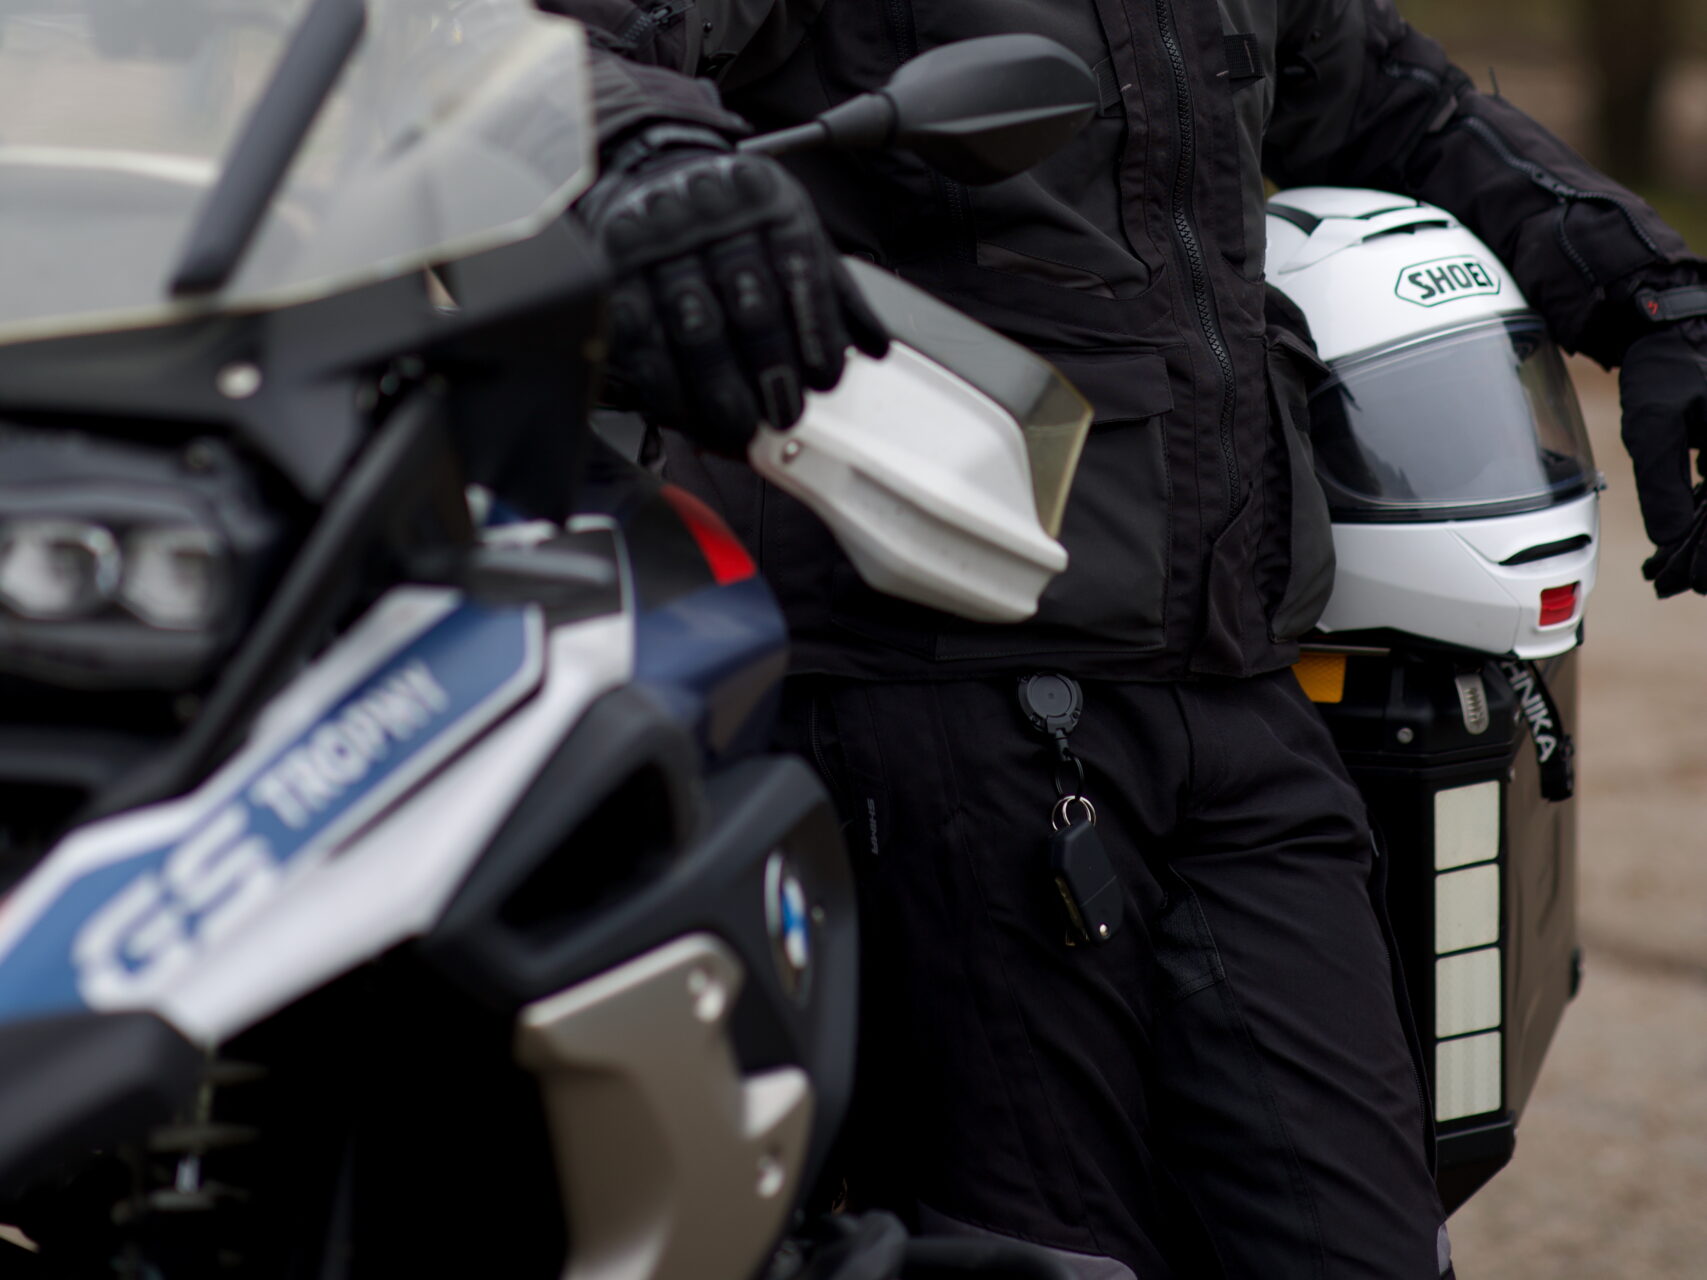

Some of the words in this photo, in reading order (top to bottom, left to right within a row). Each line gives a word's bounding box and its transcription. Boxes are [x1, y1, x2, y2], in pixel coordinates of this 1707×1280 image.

[1408, 262, 1494, 300] SHOEI
[73, 800, 282, 1012] GS
[250, 661, 449, 828] TROPHY
